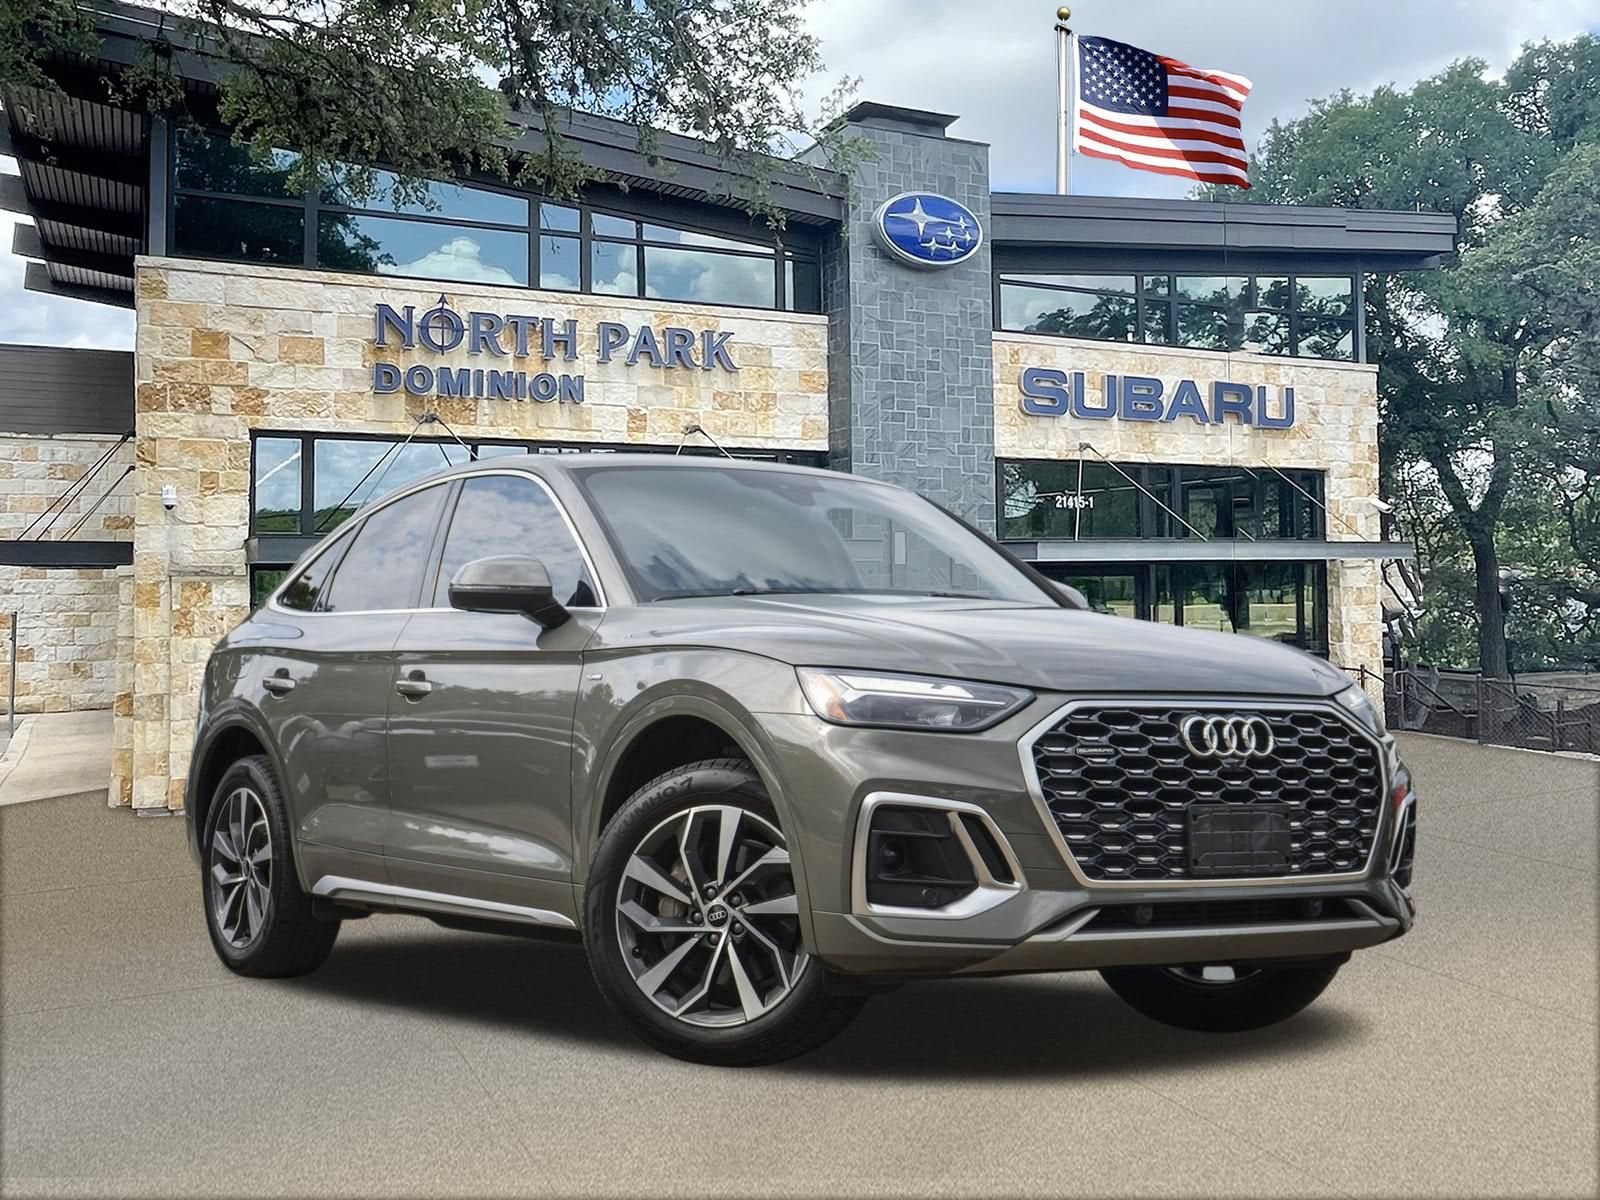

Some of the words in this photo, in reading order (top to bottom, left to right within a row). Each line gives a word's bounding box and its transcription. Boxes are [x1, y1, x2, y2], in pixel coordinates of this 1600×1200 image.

[374, 298, 580, 361] NORTH
[596, 321, 741, 373] PARK
[373, 362, 585, 404] DOMINION
[1018, 367, 1295, 430] SUBARU
